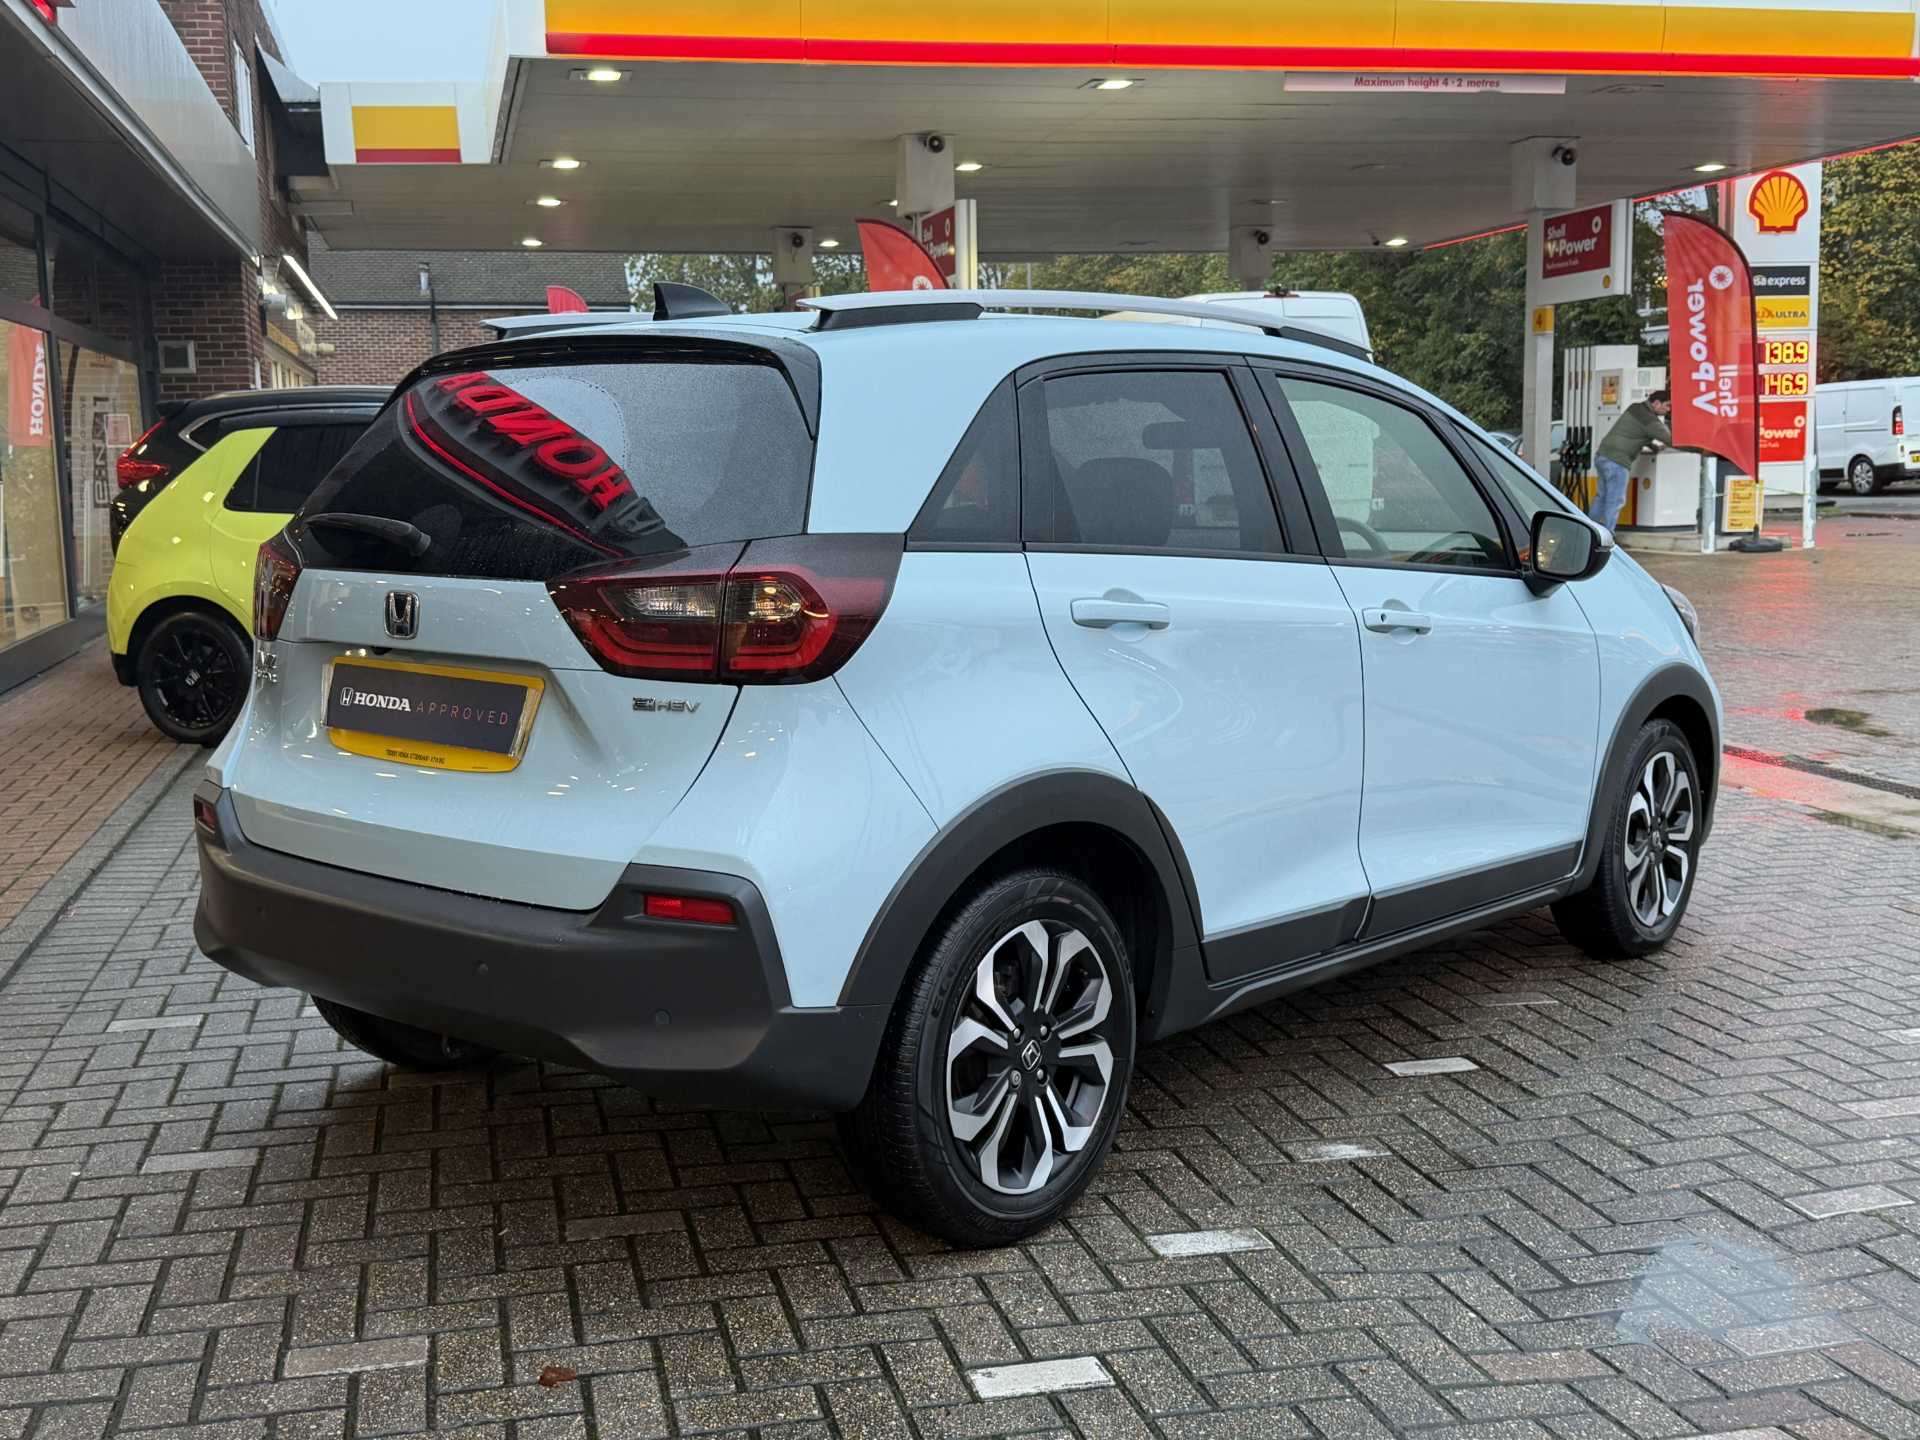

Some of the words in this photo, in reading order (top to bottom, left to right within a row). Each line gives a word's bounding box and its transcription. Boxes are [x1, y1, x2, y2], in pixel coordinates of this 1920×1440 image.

[1354, 76, 1405, 88] Maximum
[1407, 76, 1439, 90] height
[1466, 78, 1500, 89] metres
[1547, 223, 1566, 240] Shell
[1547, 236, 1597, 258] V-Power
[1767, 276, 1806, 288] express
[1776, 310, 1807, 318] ULTRA
[1765, 341, 1809, 364] 138.9
[1764, 372, 1808, 396] 146.9
[354, 692, 411, 713] HONDA
[416, 701, 508, 725] APPROVED
